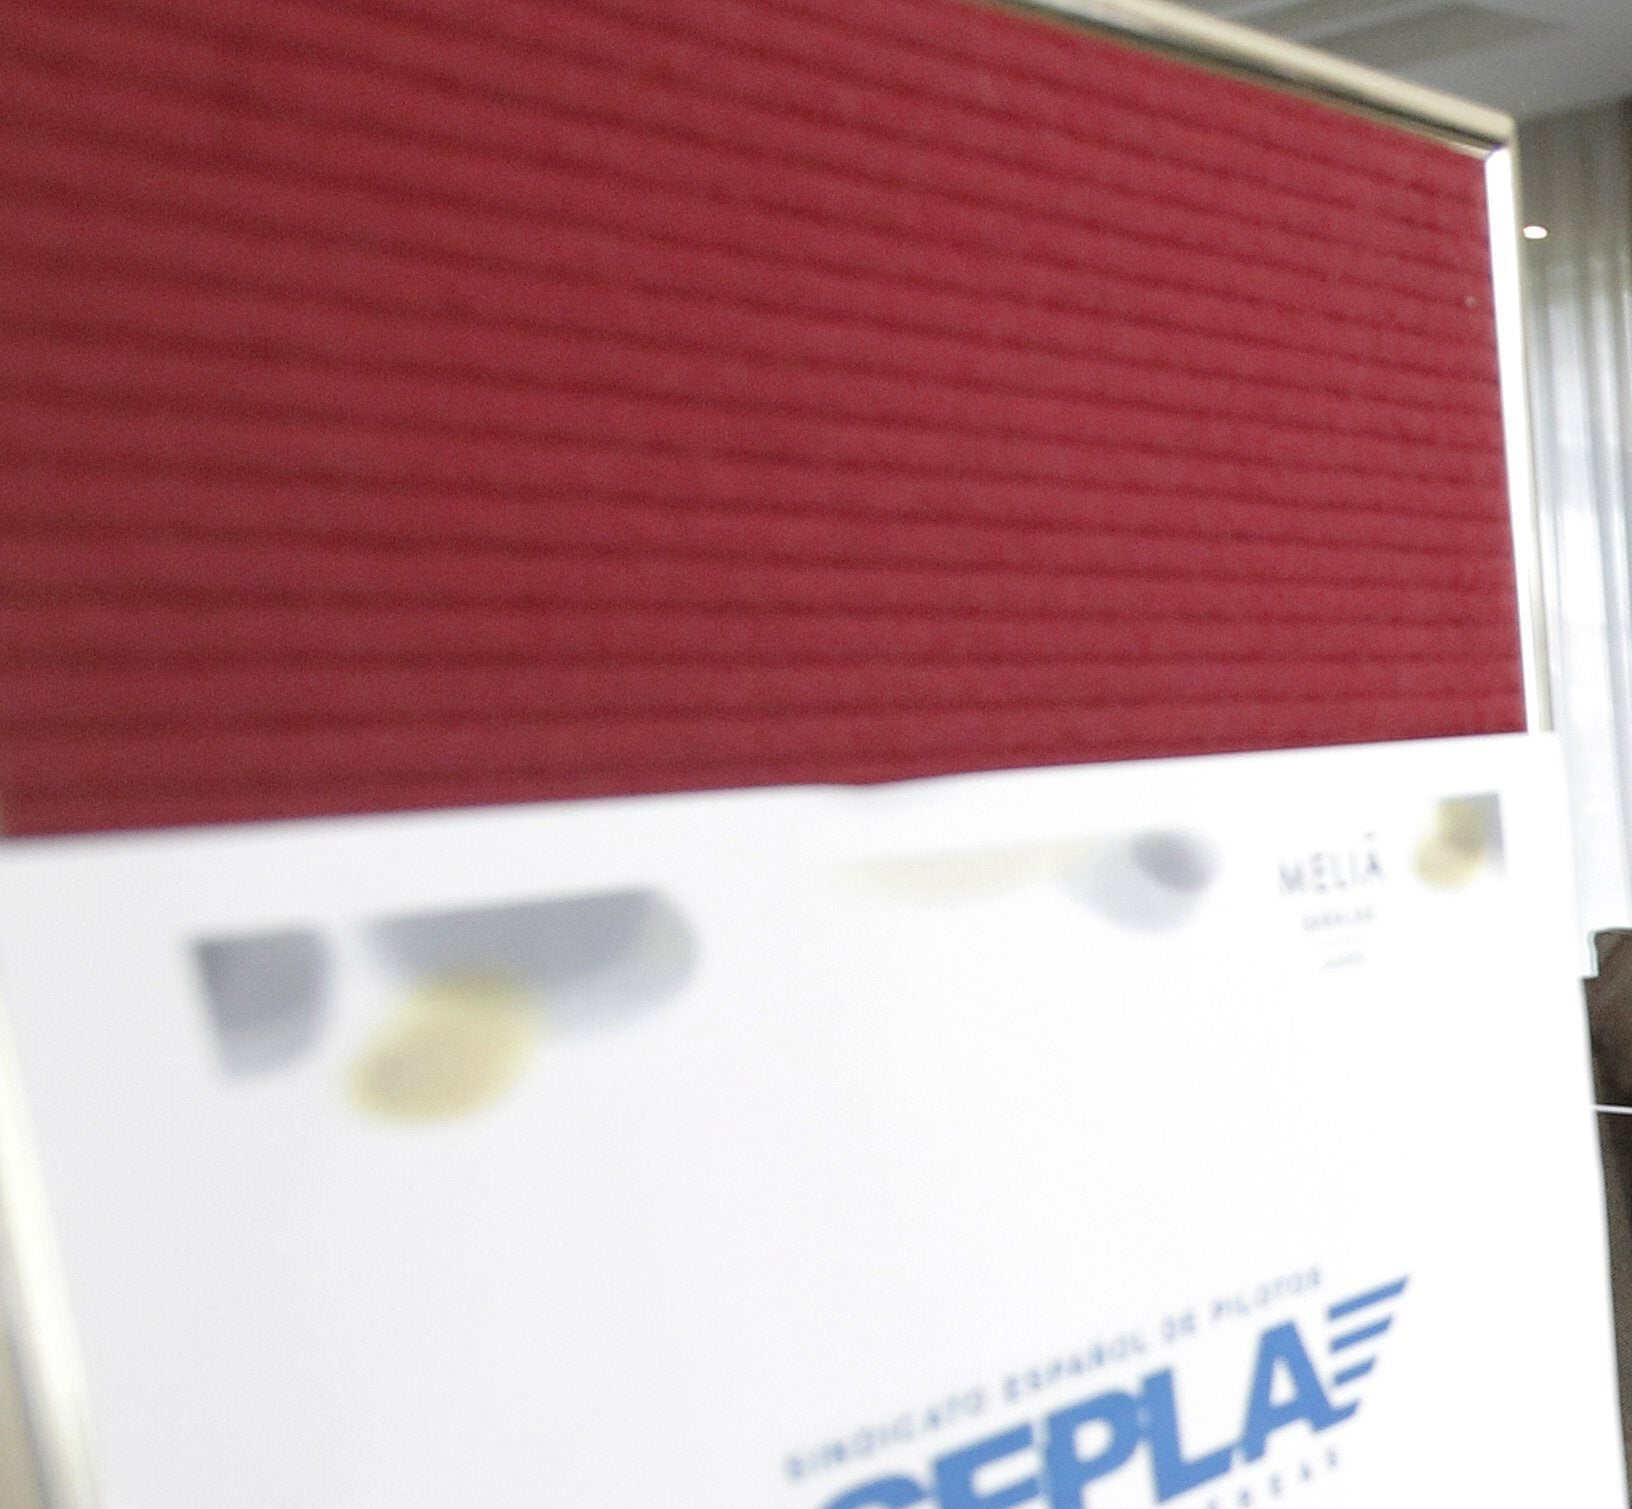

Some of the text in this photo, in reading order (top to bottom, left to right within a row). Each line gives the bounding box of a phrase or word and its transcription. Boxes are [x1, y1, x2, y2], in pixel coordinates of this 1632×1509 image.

[784, 1265, 1323, 1483] SINDICATO ESPAÑOL DE PILOTOS
